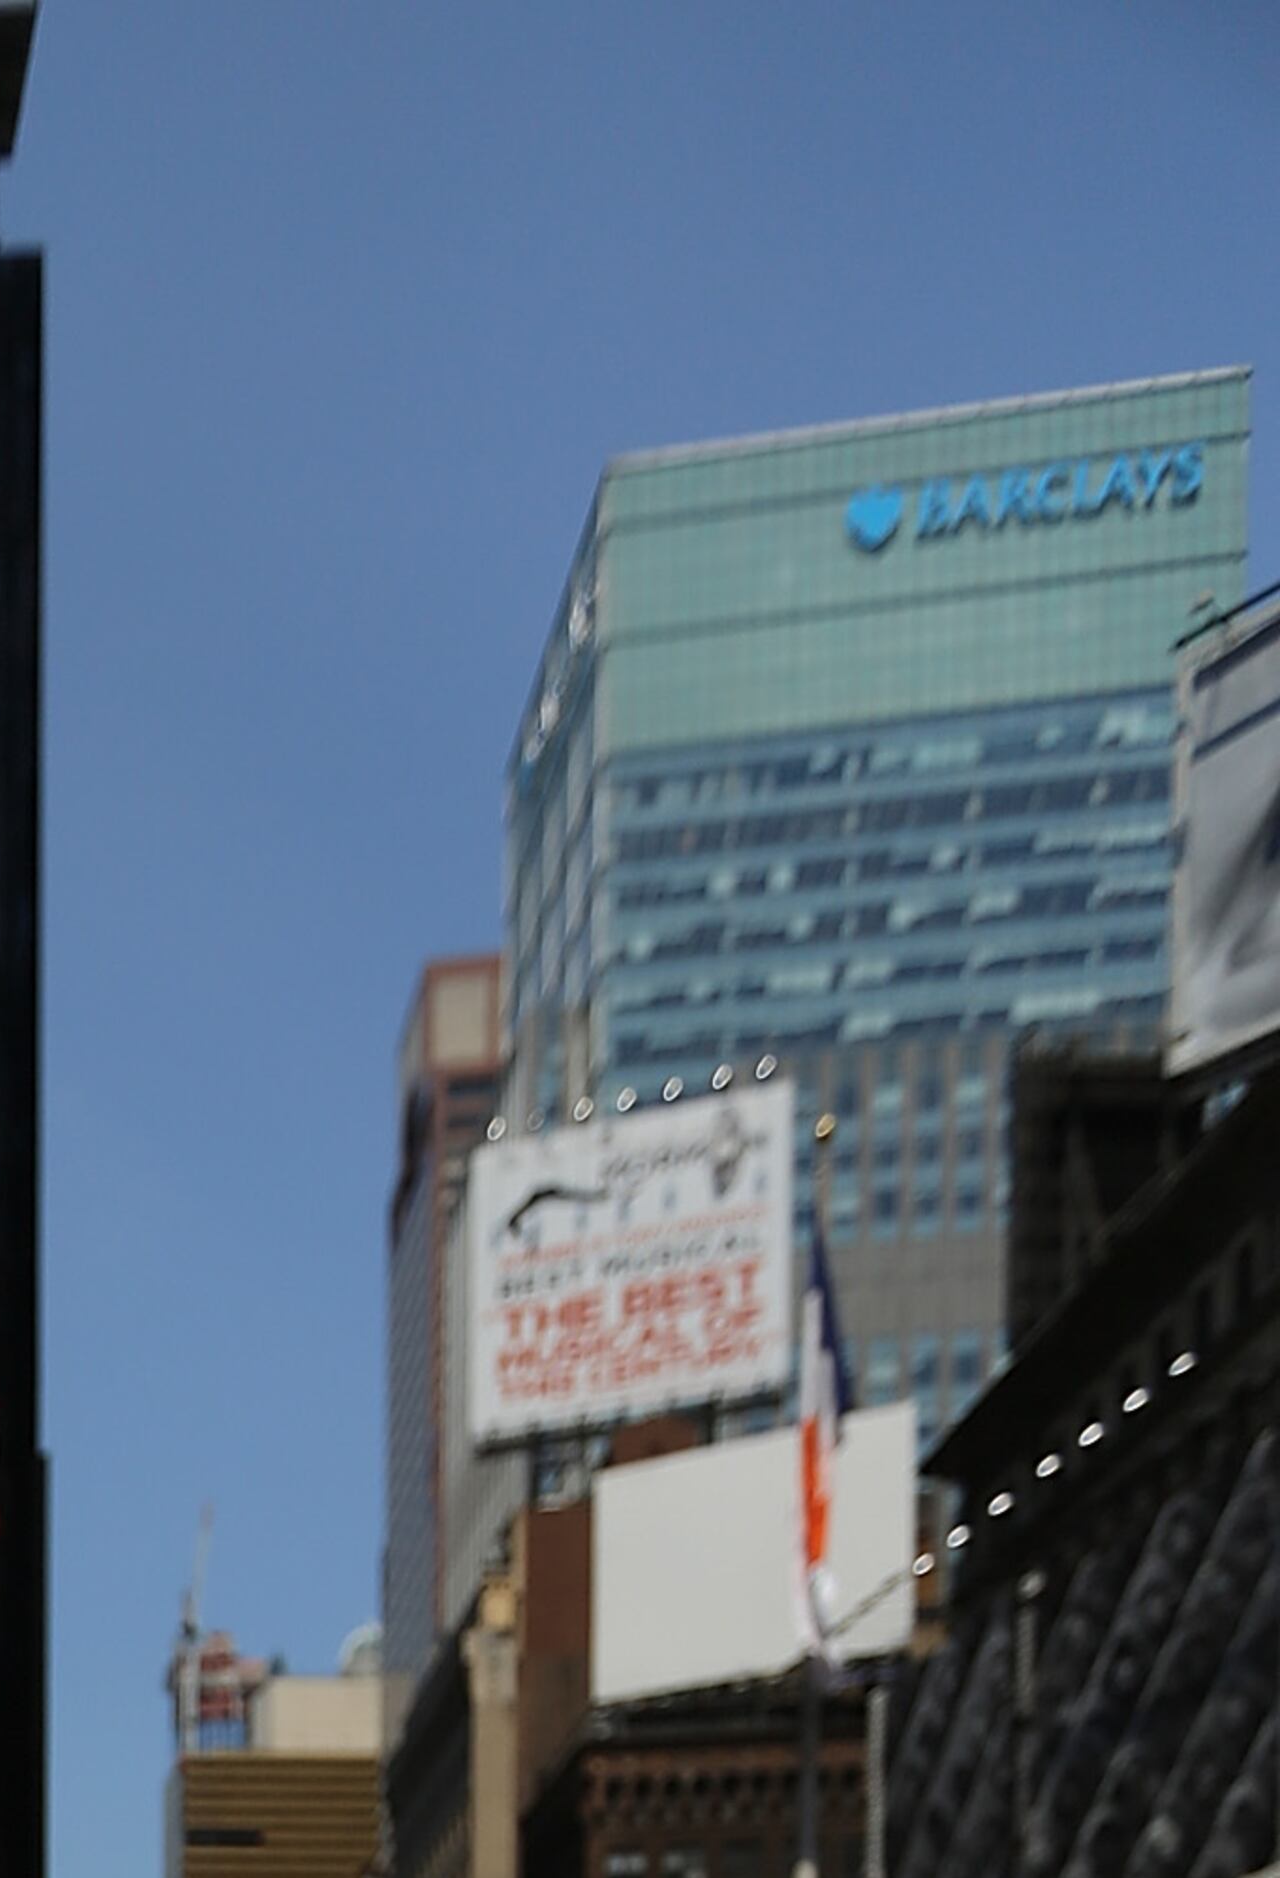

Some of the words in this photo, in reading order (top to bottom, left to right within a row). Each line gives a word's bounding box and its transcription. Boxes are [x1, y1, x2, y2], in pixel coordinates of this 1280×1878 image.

[912, 442, 1206, 540] BARCLAYS
[504, 1290, 606, 1338] THE
[620, 1257, 762, 1318] BEST
